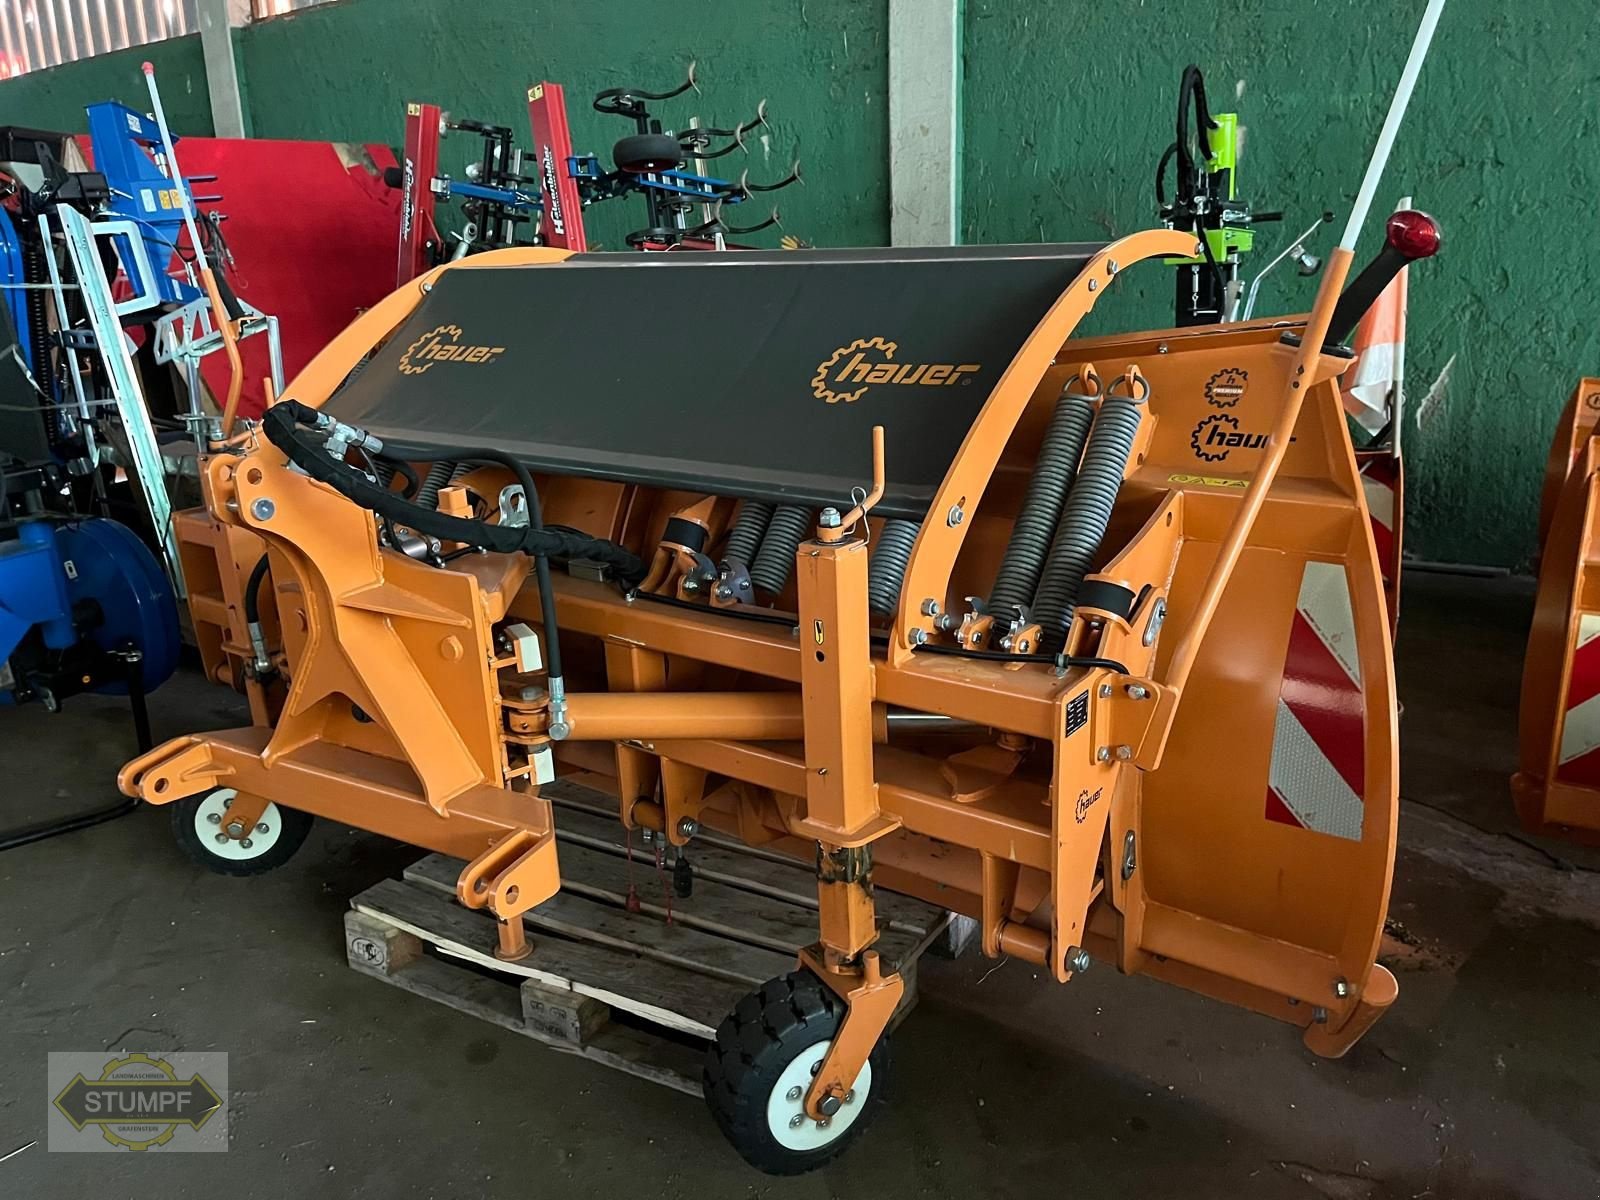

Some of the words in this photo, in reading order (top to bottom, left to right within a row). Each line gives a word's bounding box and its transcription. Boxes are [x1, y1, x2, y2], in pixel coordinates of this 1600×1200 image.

[415, 336, 506, 363] hauer
[834, 352, 981, 385] hauer
[1080, 787, 1103, 814] hauer
